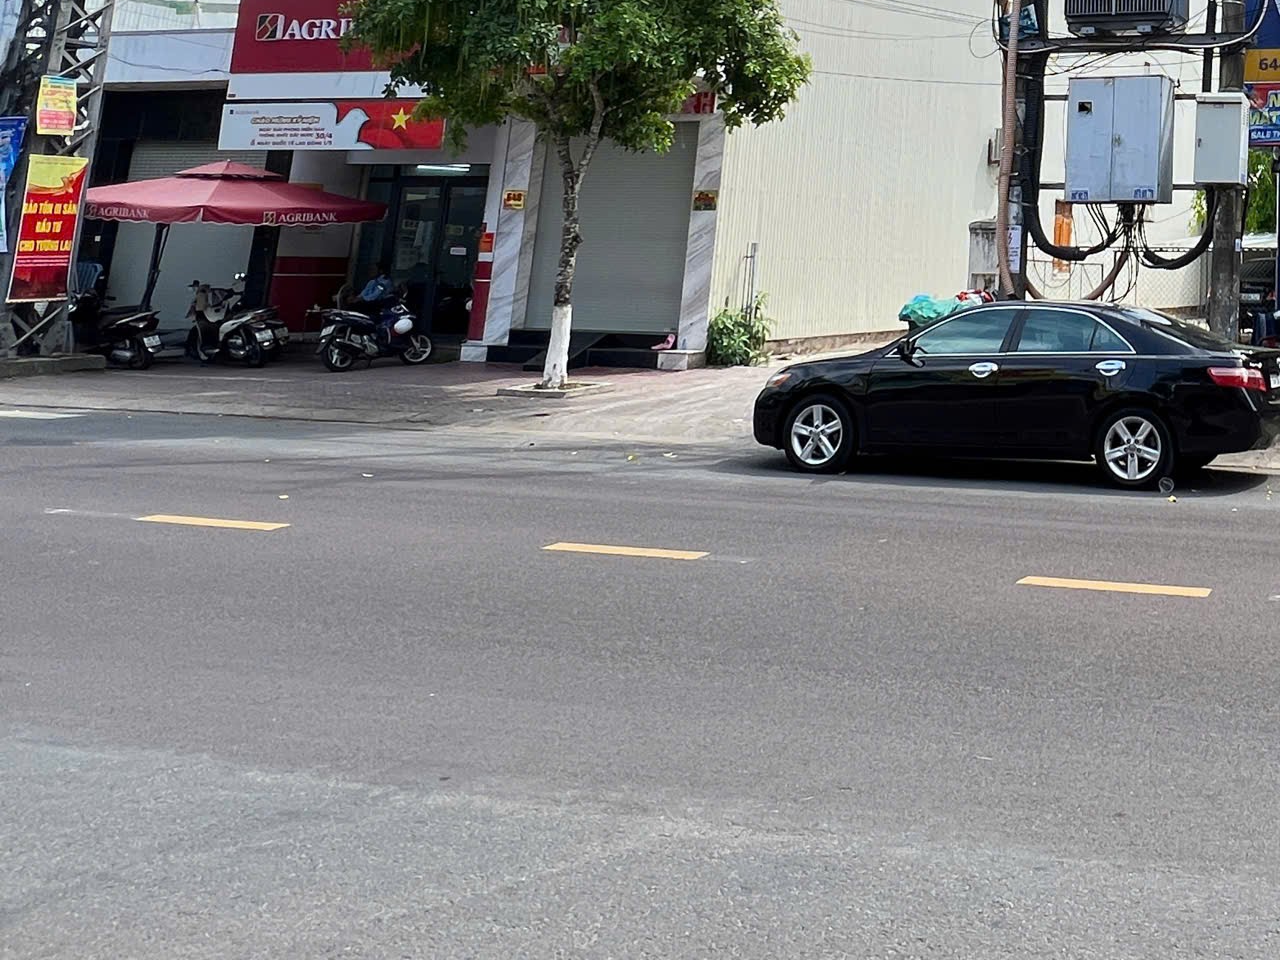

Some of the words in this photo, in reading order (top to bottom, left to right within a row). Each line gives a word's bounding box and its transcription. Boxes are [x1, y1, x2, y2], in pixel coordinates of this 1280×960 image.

[283, 18, 353, 40] AGRI
[1251, 130, 1271, 139] SALE
[97, 206, 149, 219] AGRIBANK
[278, 211, 338, 223] AGRIBANK
